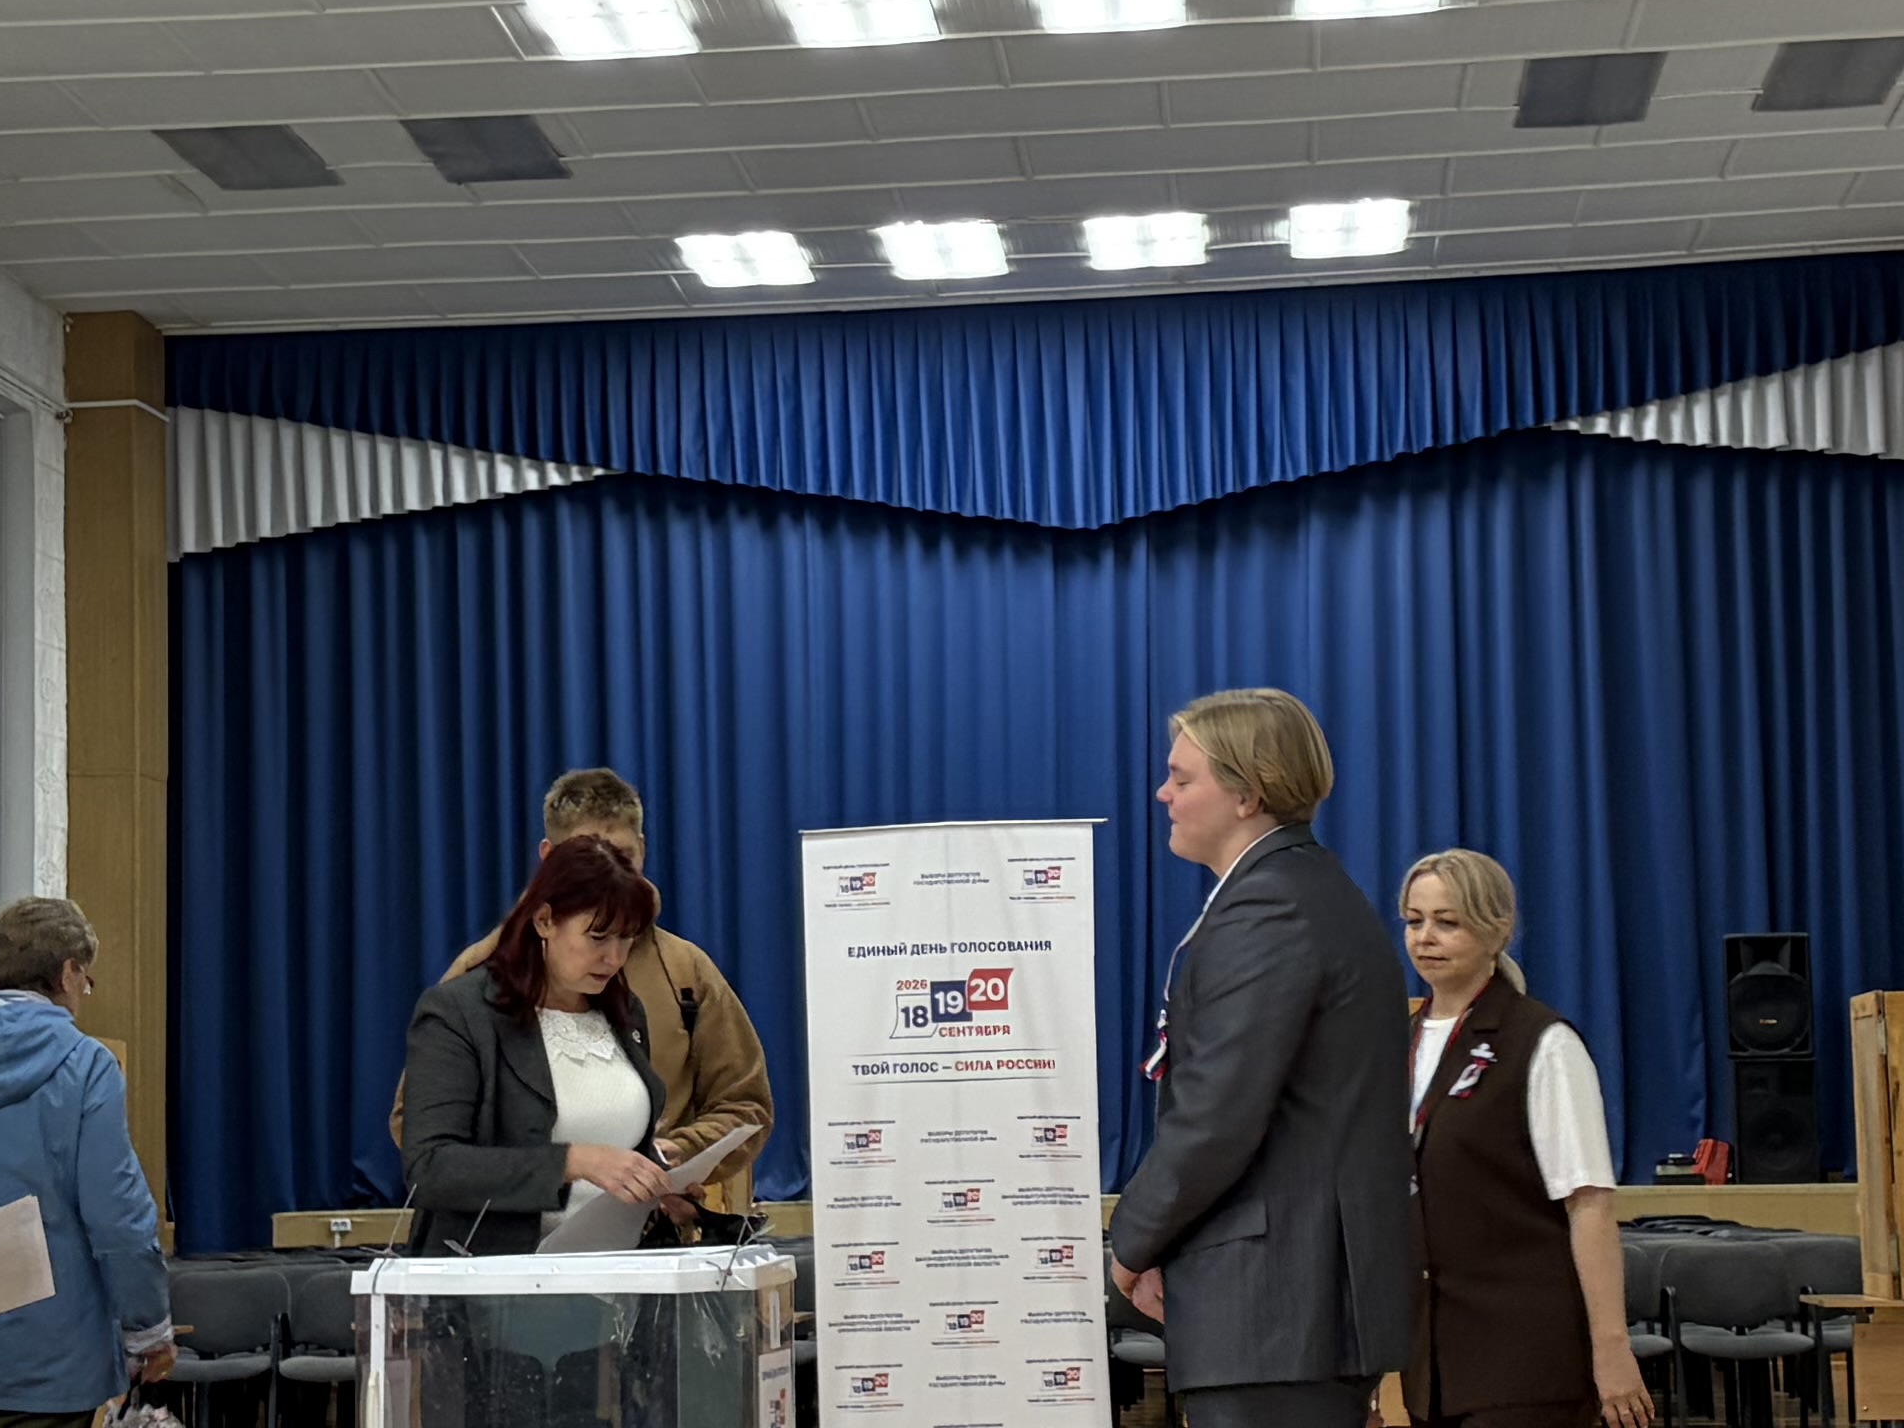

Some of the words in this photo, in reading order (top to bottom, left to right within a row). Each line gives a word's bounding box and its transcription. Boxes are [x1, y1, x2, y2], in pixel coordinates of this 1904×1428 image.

[848, 942, 907, 958] ЕДИНЫЙ
[910, 944, 947, 957] ДЕНЬ
[950, 940, 1052, 954] ГОЛОСОВАНИЯ
[896, 980, 928, 990] 2026
[901, 1005, 929, 1028] 18
[934, 991, 964, 1014] 19
[969, 978, 1005, 1002] 20
[938, 1024, 1010, 1038] СЕНТЯБРЯ
[852, 1060, 890, 1076] ТВОЙ
[893, 1062, 938, 1074] ГОЛОС
[954, 1060, 993, 1072] СИЛА
[997, 1059, 1056, 1070] РОССИИ!
